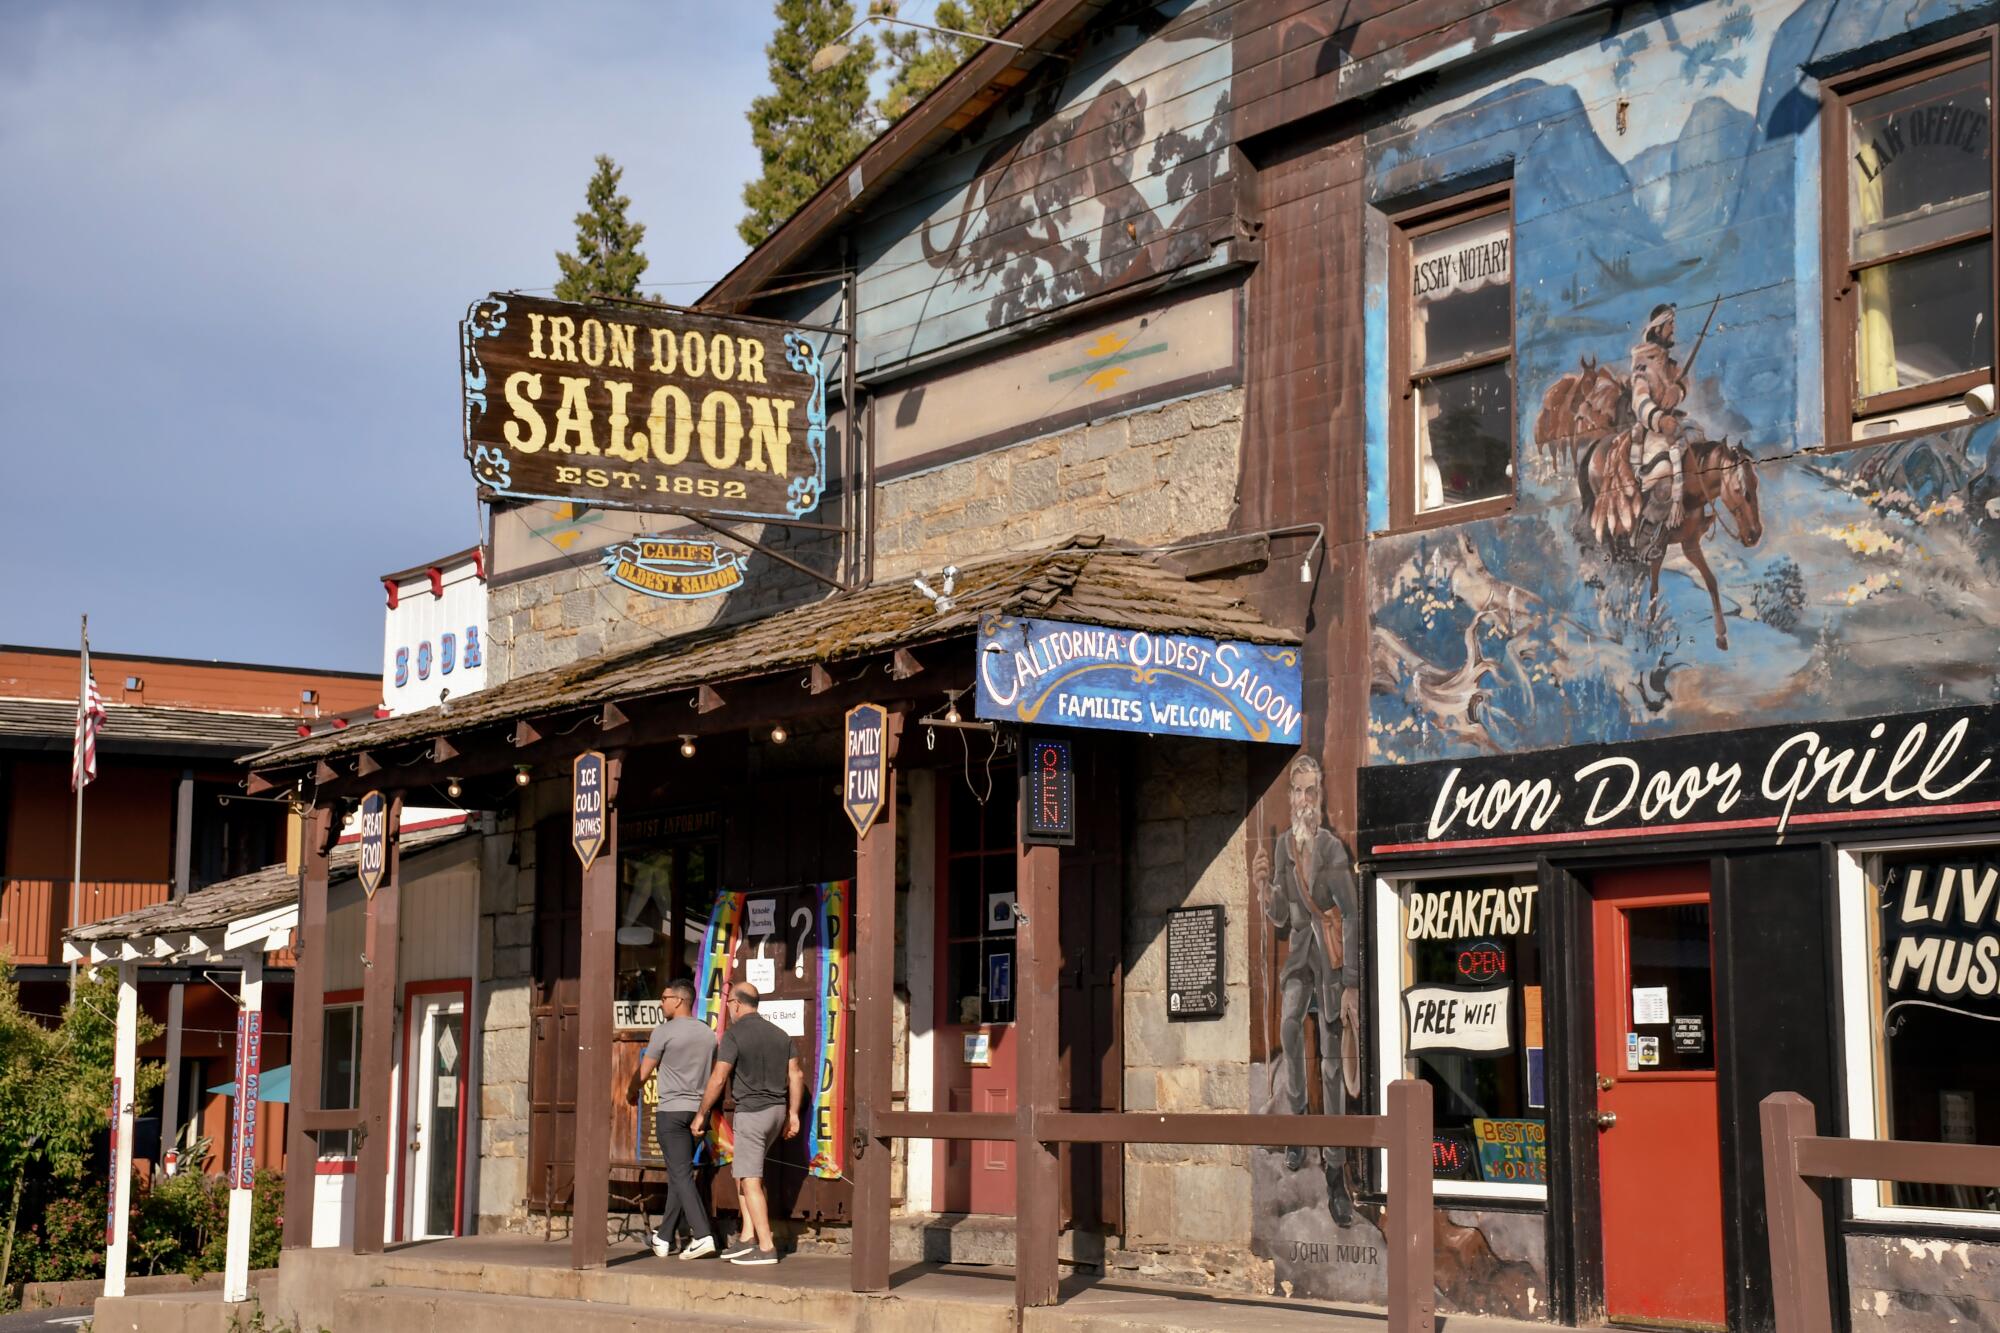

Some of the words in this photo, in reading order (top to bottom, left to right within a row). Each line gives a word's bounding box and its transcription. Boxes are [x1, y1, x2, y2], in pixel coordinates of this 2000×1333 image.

[1909, 106, 1987, 153] OFFICE
[1413, 254, 1452, 297] ASSAY
[1459, 238, 1509, 283] NOTARY
[527, 312, 636, 371] IRON
[649, 327, 767, 384] DOOR
[503, 371, 796, 479] SALOON
[556, 466, 646, 491] EST.
[655, 474, 748, 500] 1852
[617, 561, 678, 593] OLDEST
[681, 566, 738, 594] SALOON
[394, 625, 482, 688] SODA
[1129, 631, 1211, 677] OLDEST
[1211, 644, 1301, 736] SALOON
[1058, 693, 1143, 723] FAMILIES
[1150, 701, 1232, 731] WELCOME
[848, 728, 882, 758] FAMILY
[580, 768, 597, 786] ICE
[848, 769, 879, 800] FUN
[1042, 748, 1059, 826] OPEN
[1427, 767, 1561, 840] Iron
[1574, 756, 1742, 827] Door
[1761, 716, 1992, 845] Grill
[575, 791, 600, 813] COLD
[362, 812, 383, 837] GREAT
[575, 818, 601, 837] DRINKS
[362, 842, 382, 870] FOOD
[1406, 885, 1539, 940] BREAKFAST
[1901, 866, 2000, 924] LIV
[1457, 951, 1506, 976] OPEN
[1888, 935, 2000, 996] MUS
[616, 1005, 665, 1025] FREEDO
[773, 1011, 778, 1020] G
[780, 1011, 797, 1020] Band
[816, 914, 841, 1141] PRIDE
[1413, 999, 1458, 1035] FREE
[248, 1012, 260, 1067] FRUIT
[243, 1074, 258, 1185] SMOOTHIES
[1482, 1121, 1523, 1143] BEST
[1432, 1141, 1459, 1168] TM
[1503, 1145, 1523, 1159] IN
[1289, 1241, 1329, 1263] JOHN
[1336, 1244, 1379, 1265] MUIR
